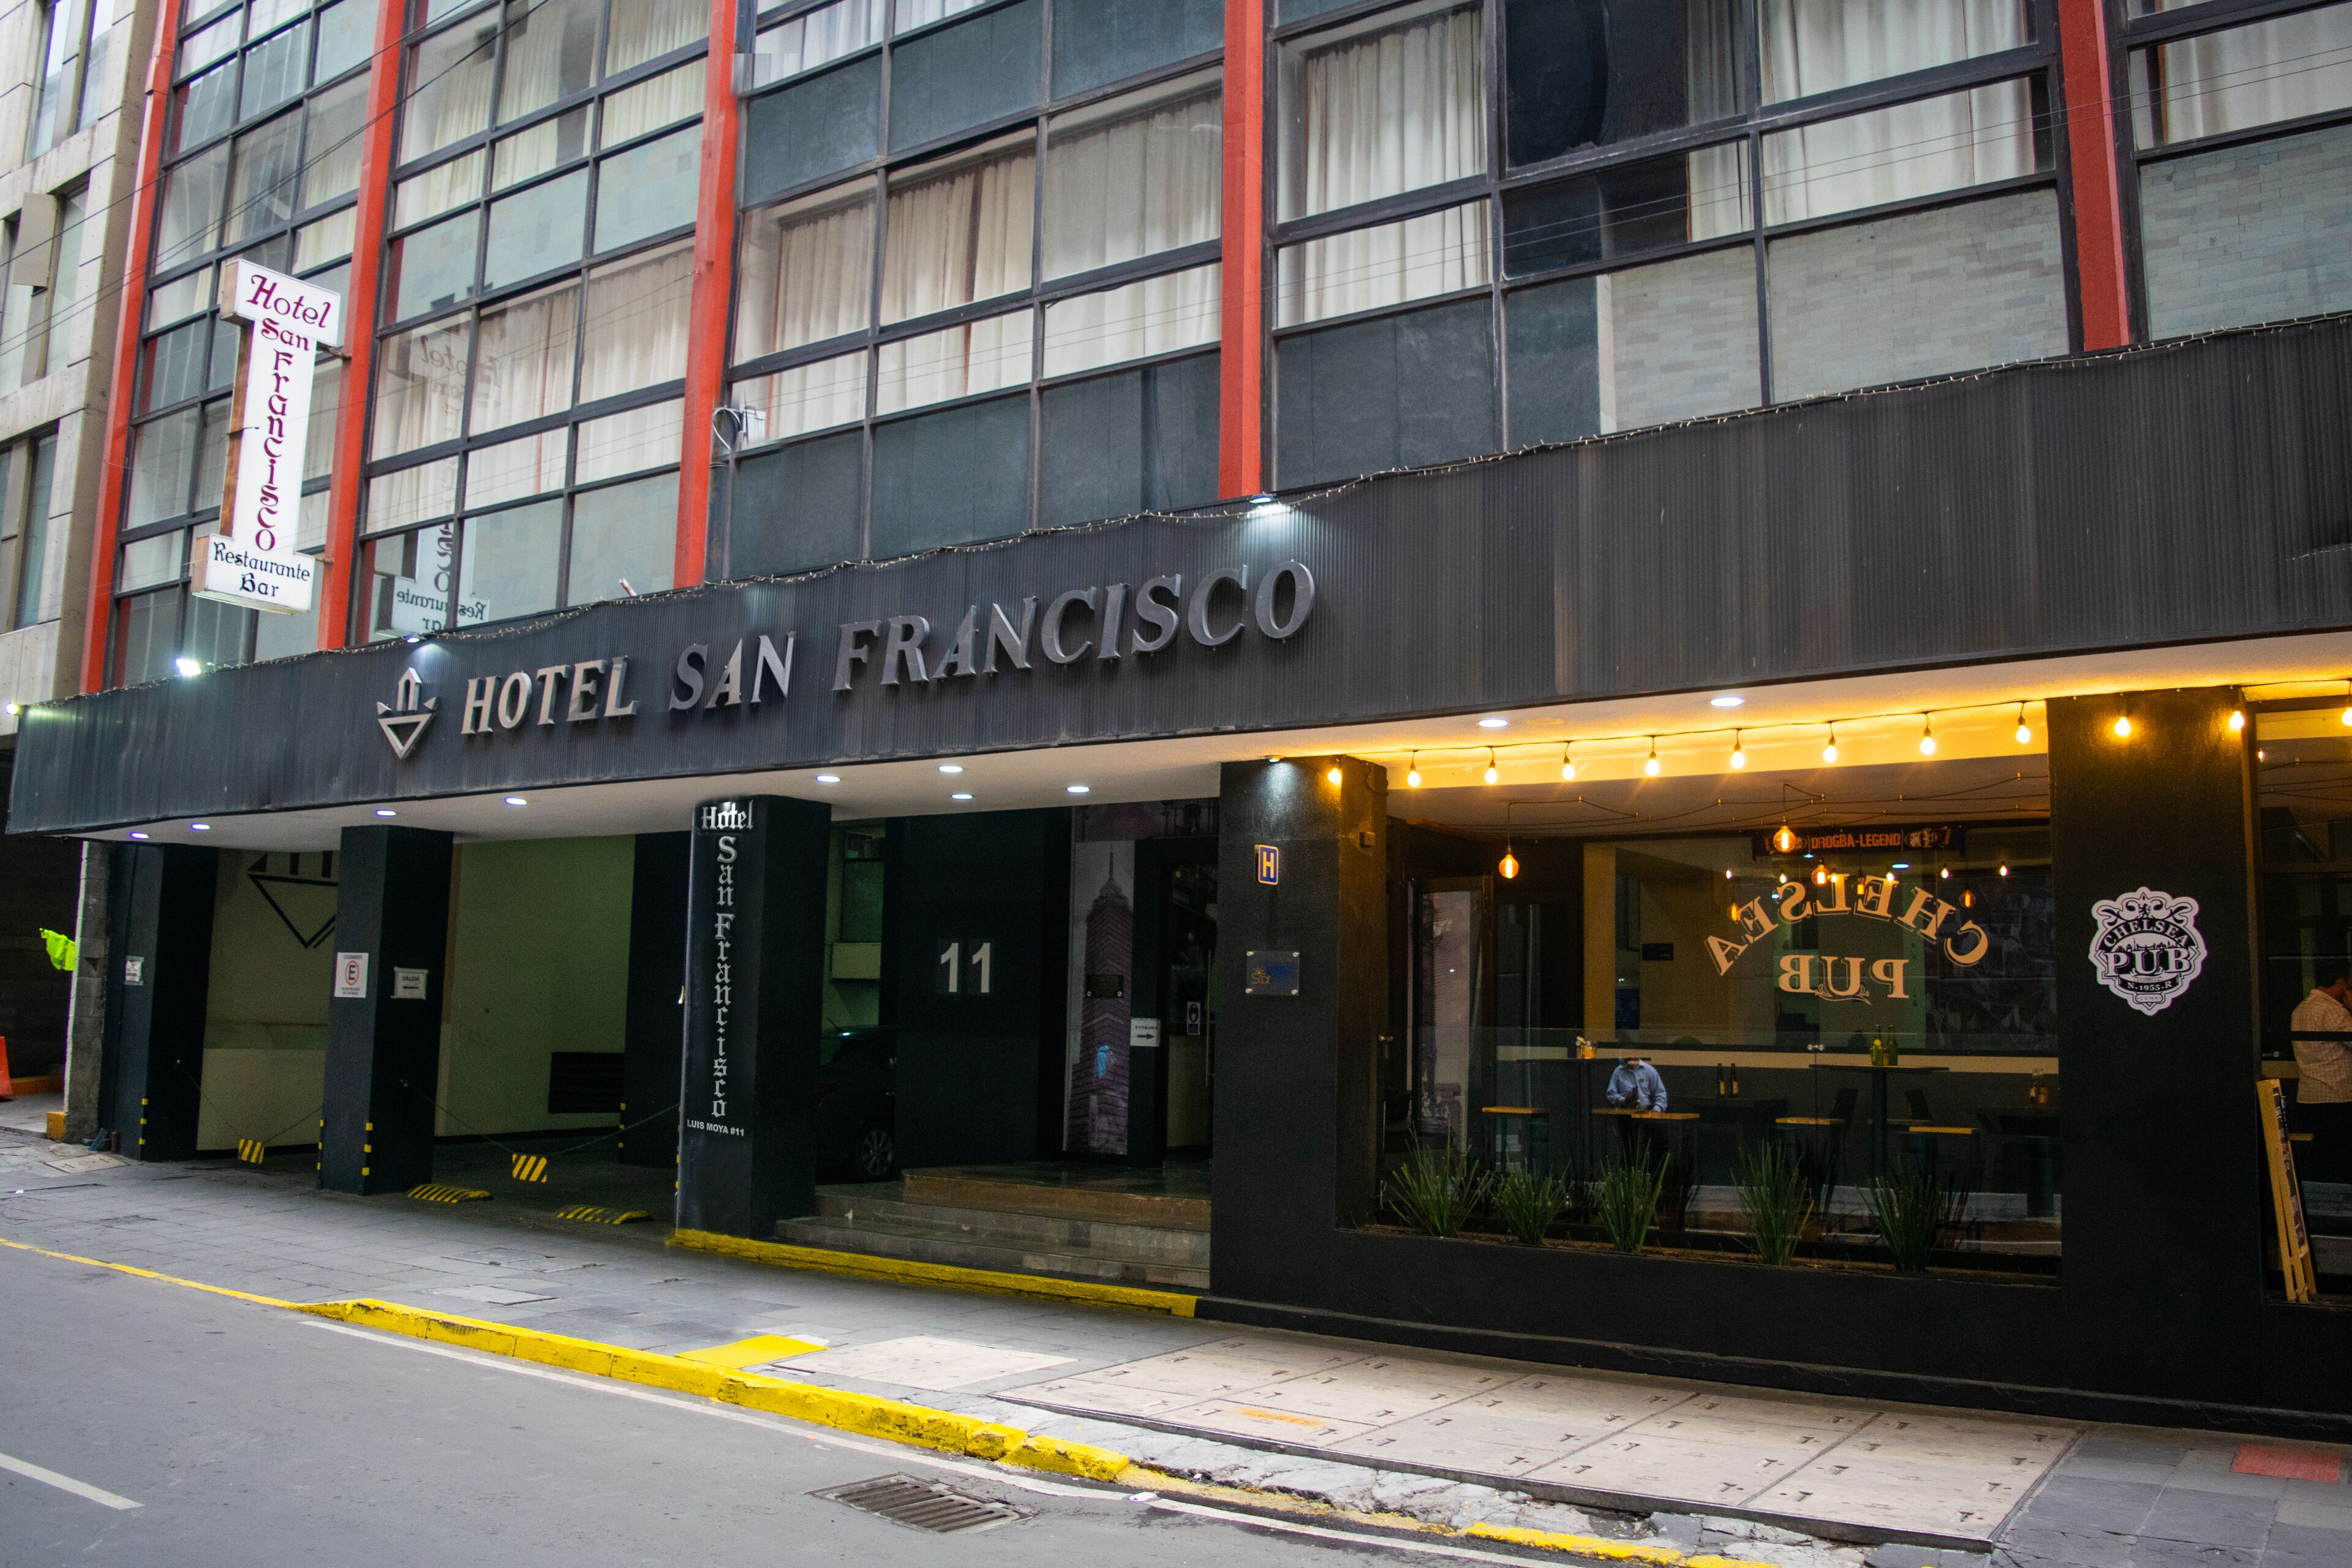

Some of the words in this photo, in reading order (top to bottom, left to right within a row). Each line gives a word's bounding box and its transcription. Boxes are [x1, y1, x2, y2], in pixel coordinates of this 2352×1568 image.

[246, 274, 331, 328] Hotel
[260, 317, 310, 351] San
[255, 349, 293, 551] Francisco
[213, 542, 311, 582] Restaurante
[239, 573, 279, 598] Bar
[461, 655, 639, 735] HOTEL
[668, 631, 796, 711] SAN
[831, 559, 1315, 692] FRANCISCO
[701, 799, 754, 831] Hotel
[1811, 832, 1901, 849] DROGBA-LEGEND
[717, 835, 737, 907] San
[1262, 851, 1275, 878] H
[2104, 919, 2190, 948] CHELSEA
[348, 964, 356, 981] E
[940, 942, 991, 993] 11
[2103, 946, 2192, 978] PUB
[711, 912, 736, 1118] Francisco
[687, 1119, 705, 1129] LUIS
[706, 1122, 729, 1134] MOYA
[729, 1126, 745, 1137] #11
